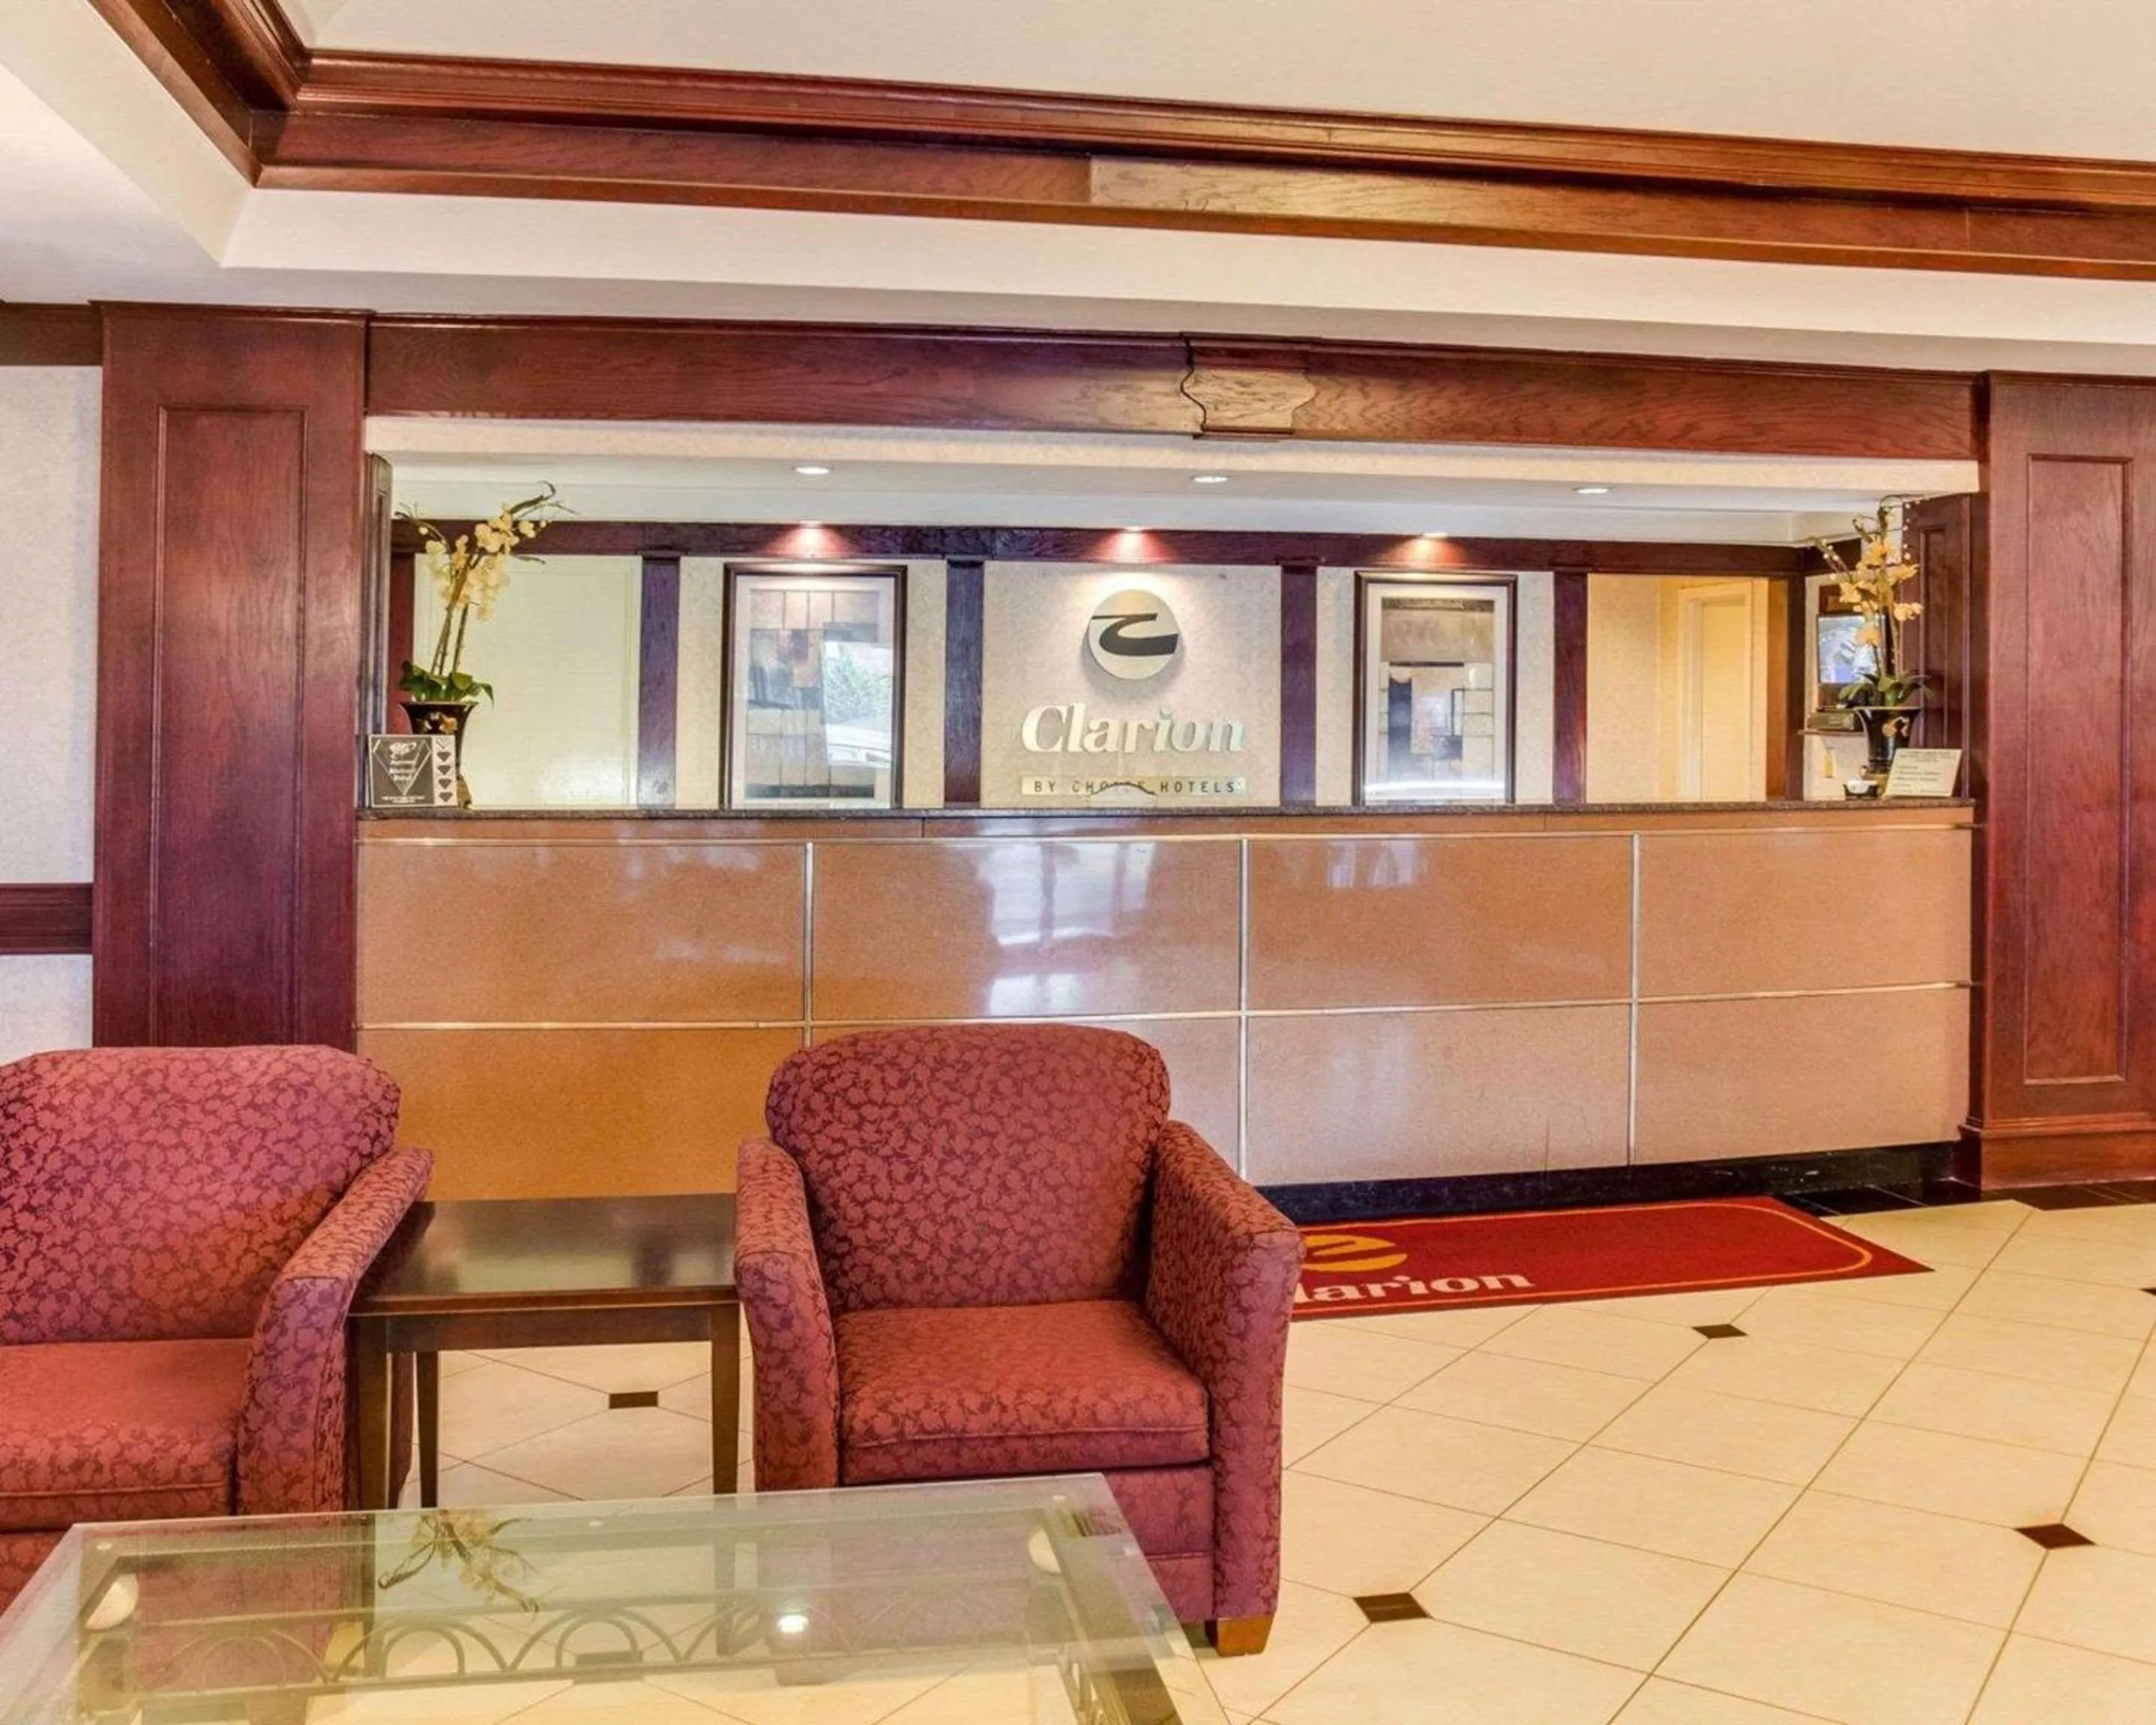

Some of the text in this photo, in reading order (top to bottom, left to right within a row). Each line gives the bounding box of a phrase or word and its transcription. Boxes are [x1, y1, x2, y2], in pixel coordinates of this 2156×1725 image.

[1022, 702, 1244, 752] Clarion
[1034, 781, 1056, 792] BY
[1160, 781, 1235, 793] HOTELS
[1294, 1274, 1535, 1303] larion
